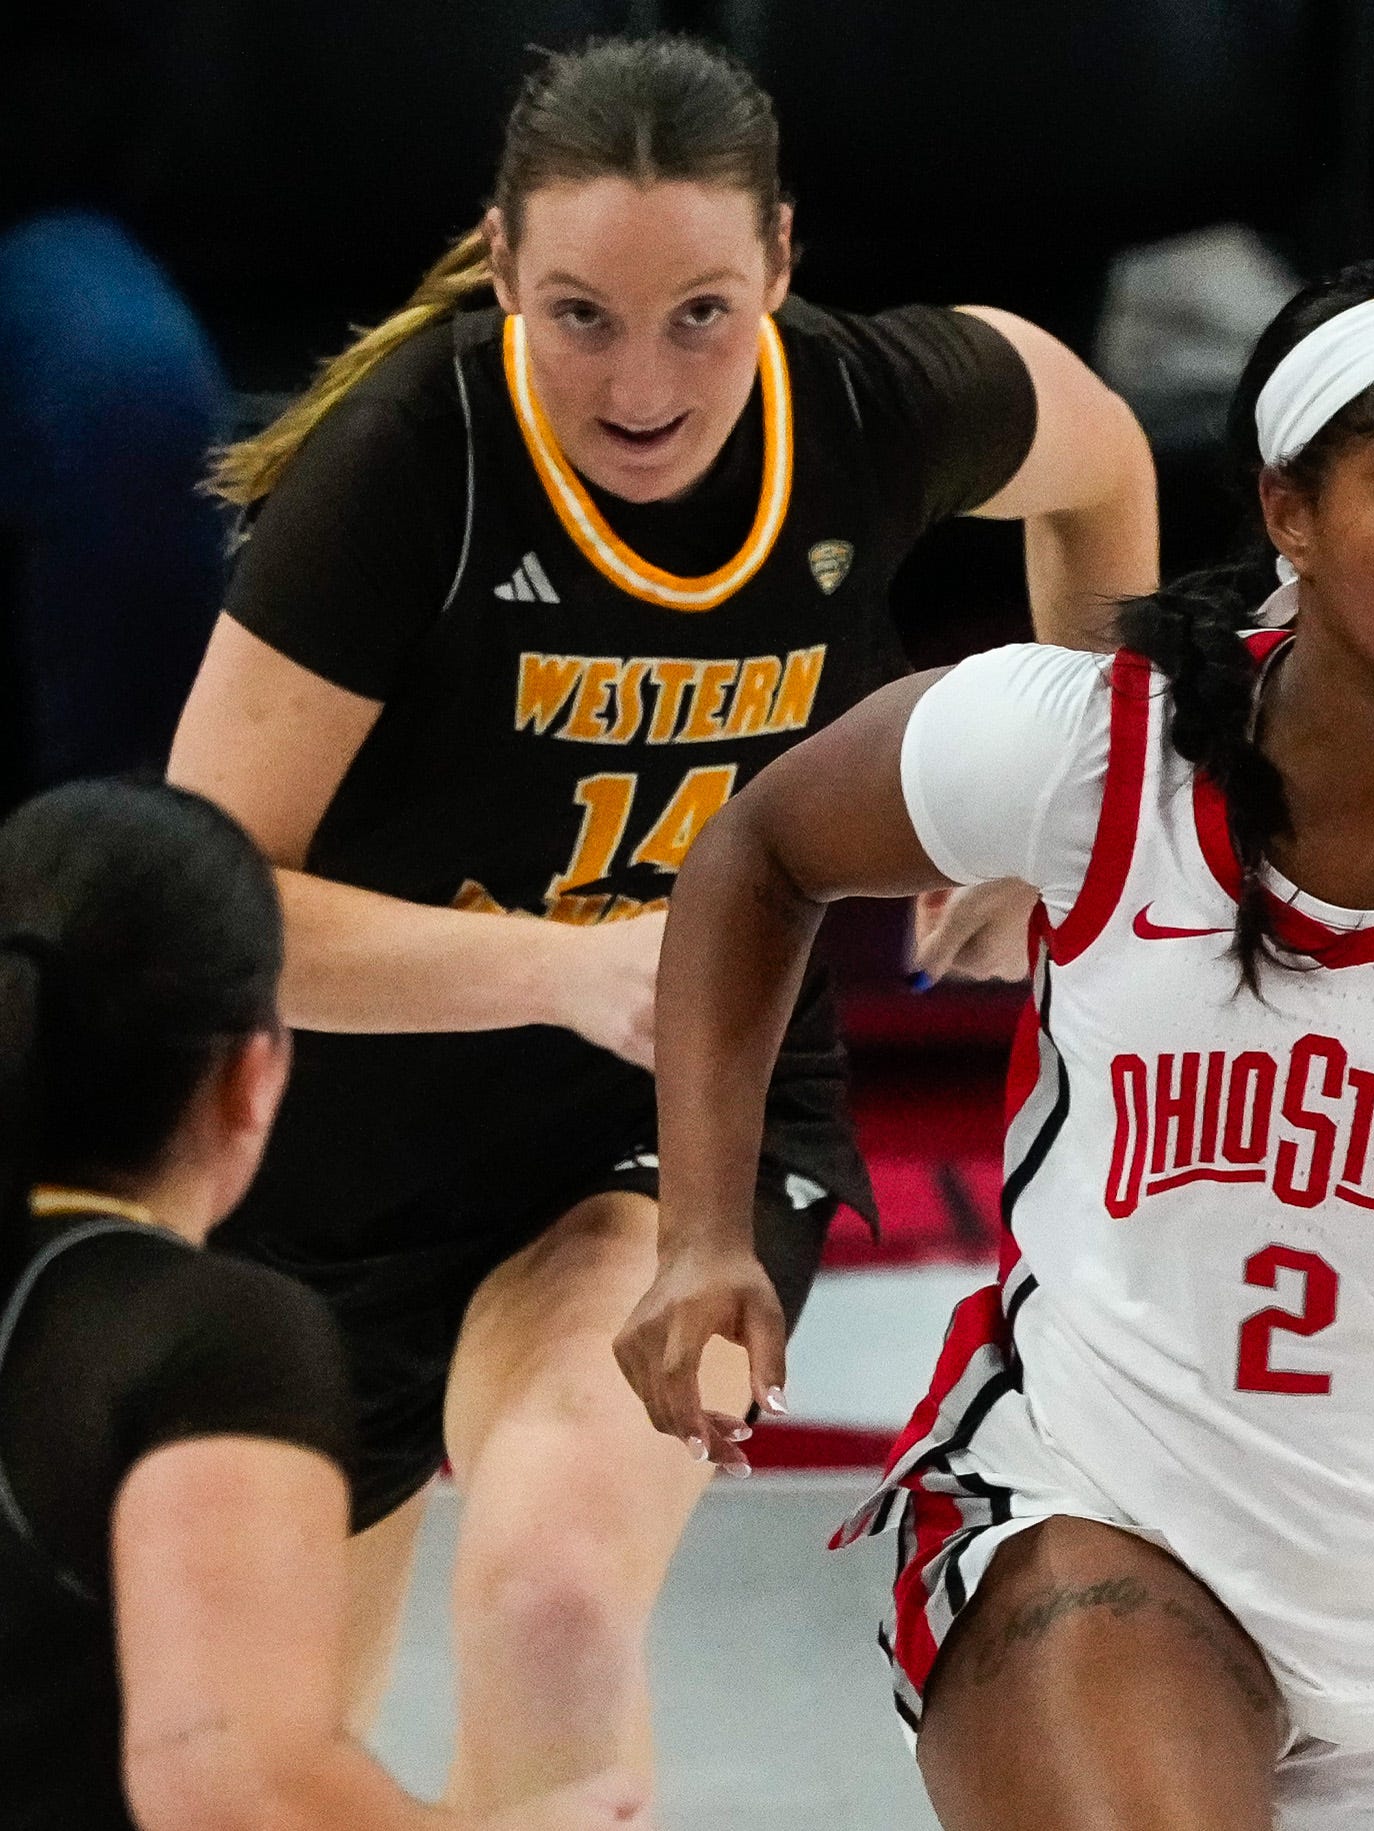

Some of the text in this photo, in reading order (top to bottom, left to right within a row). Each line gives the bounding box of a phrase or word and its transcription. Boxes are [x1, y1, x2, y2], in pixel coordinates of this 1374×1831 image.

[514, 644, 828, 745] WESTERN
[544, 763, 738, 900] 14
[1234, 1242, 1339, 1395] 2
